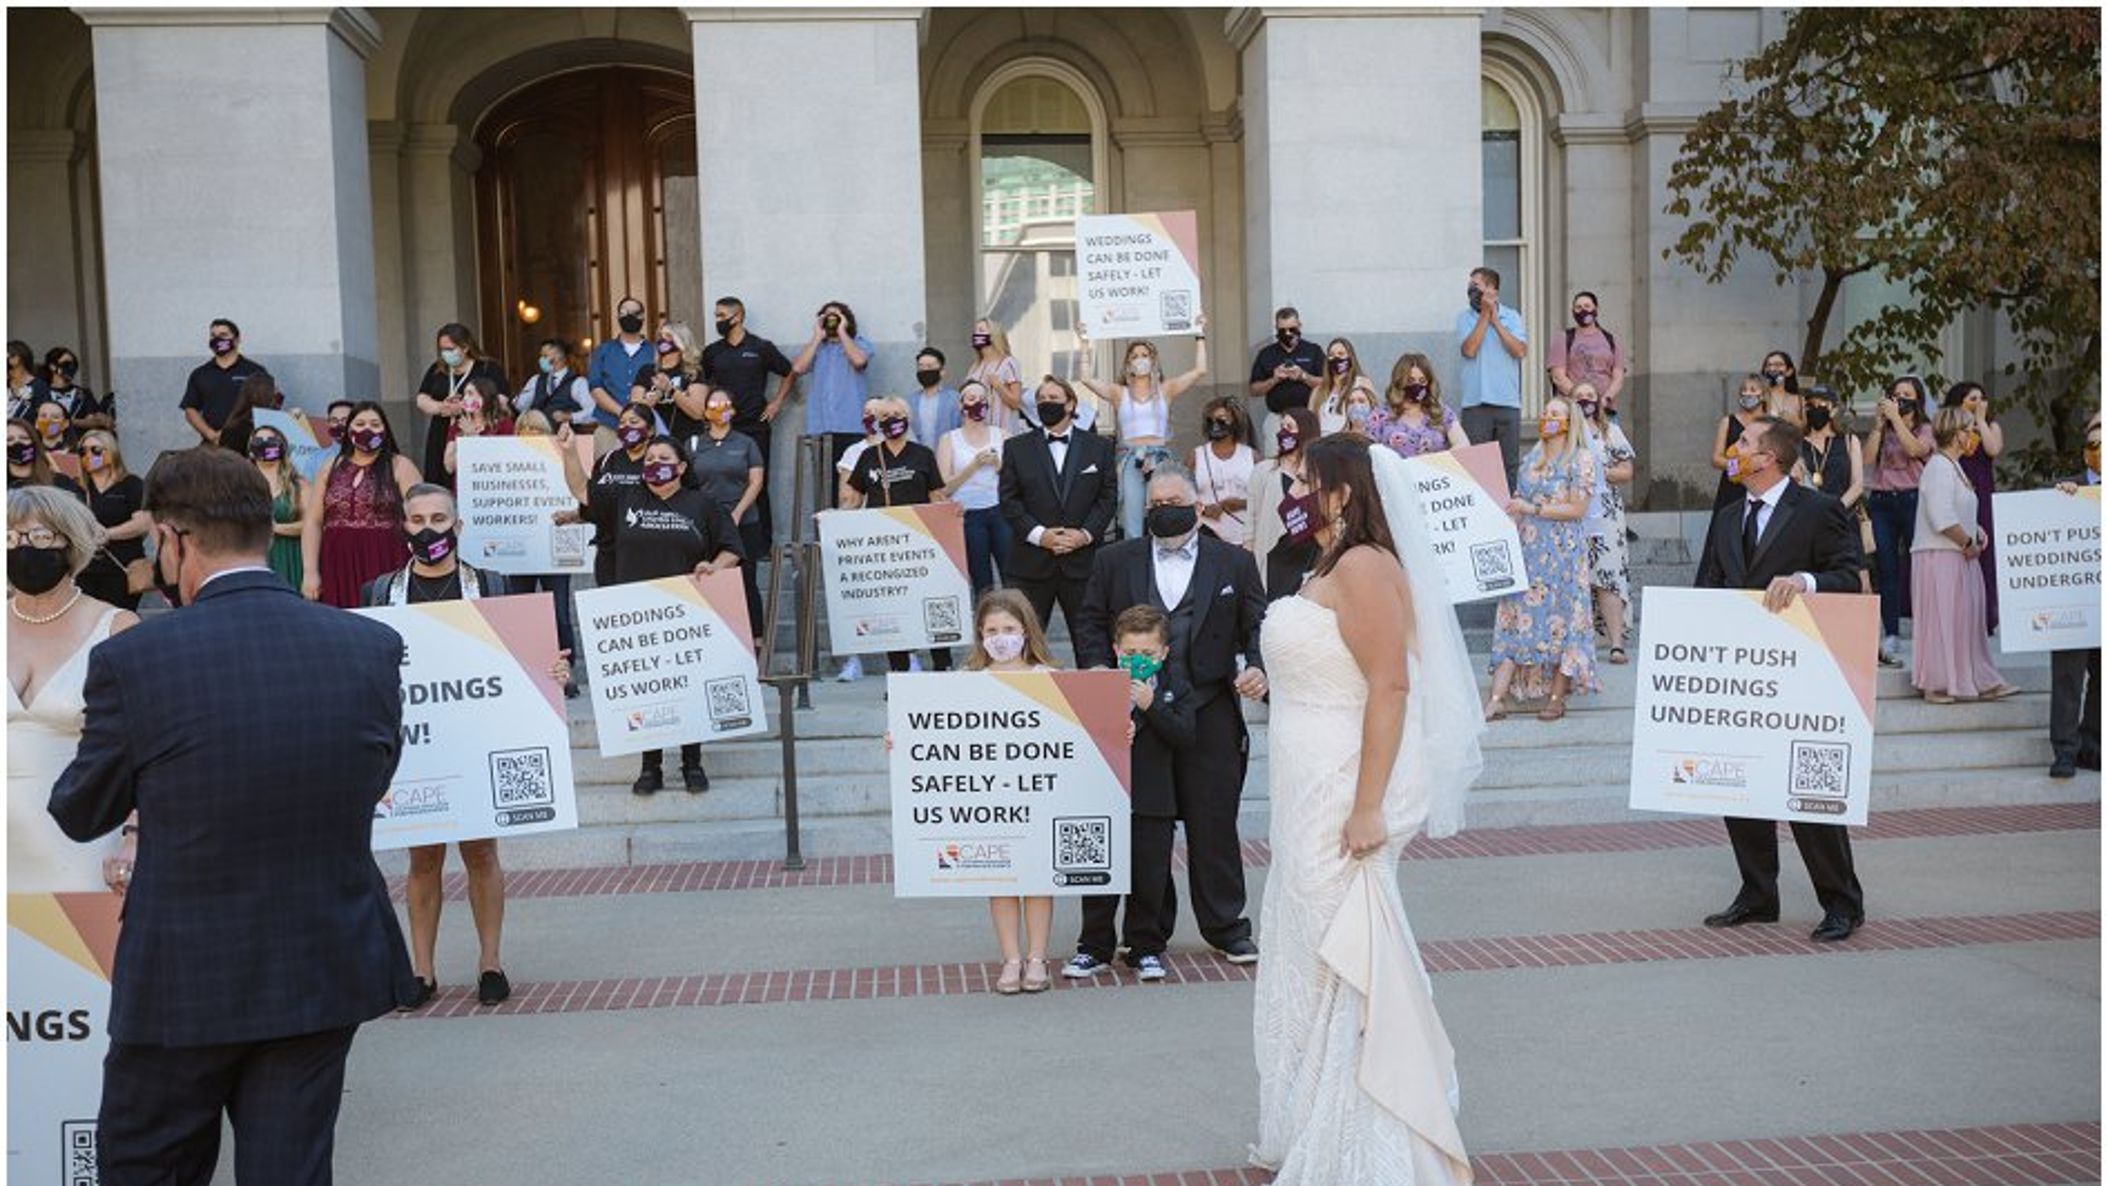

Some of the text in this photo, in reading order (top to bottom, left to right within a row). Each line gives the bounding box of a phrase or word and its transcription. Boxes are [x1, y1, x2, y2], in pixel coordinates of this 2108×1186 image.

[1085, 233, 1152, 247] WEDDINGS
[1086, 250, 1169, 264] CAN BE DONE
[1087, 270, 1130, 282] SAFELY
[1141, 267, 1161, 279] LET
[1088, 287, 1105, 299] US
[472, 462, 546, 474] SAVE SMALL
[1414, 477, 1451, 493] NGS
[472, 497, 572, 508] SUPPORT EVENT
[1431, 495, 1475, 513] DONE
[1443, 517, 1468, 531] LET
[836, 533, 910, 549] WHY AREN'T
[2007, 530, 2062, 546] DON'T
[838, 548, 935, 566] PRIVATE EVENTS
[2008, 549, 2101, 567] WEDDINGS
[840, 573, 848, 583] A
[841, 586, 908, 600] INDUSTRY?
[593, 603, 686, 630] WEDDINGS
[597, 624, 712, 654] CAN BE DONE
[601, 656, 661, 678] SAFELY
[676, 648, 704, 665] LET
[1654, 643, 1797, 667] DON'T PUSH
[605, 675, 688, 701] US WORK!
[1652, 674, 1778, 697] WEDDINGS
[908, 710, 1041, 730] WEDDINGS
[1650, 705, 1846, 734] UNDERGROUND!
[910, 741, 1074, 761] CAN BE DONE
[1695, 759, 1746, 778] CAPE
[911, 774, 997, 793] SAFELY
[1018, 773, 1058, 792] LET
[393, 785, 447, 804] CAPE
[512, 811, 533, 822] SCAN
[913, 805, 1030, 824] US WORK!
[960, 844, 1010, 860] CAPE
